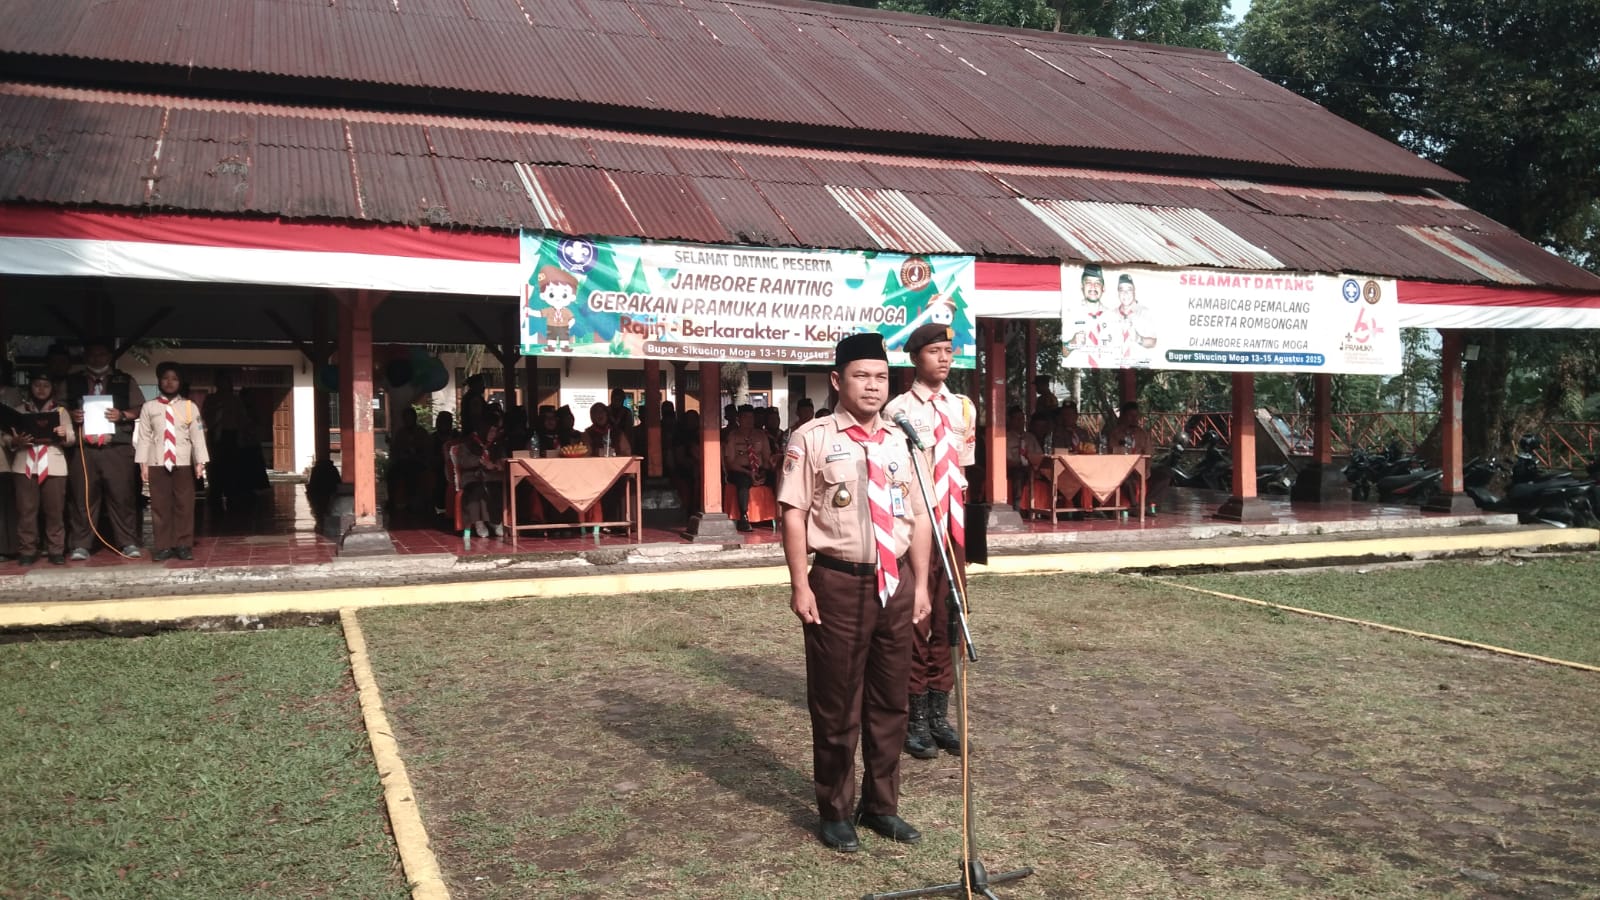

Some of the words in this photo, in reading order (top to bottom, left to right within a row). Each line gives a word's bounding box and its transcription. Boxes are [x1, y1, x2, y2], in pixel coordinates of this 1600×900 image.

[674, 250, 729, 267] SELAMAT
[734, 253, 778, 270] DATANG
[782, 258, 833, 273] PESERTA
[671, 273, 758, 294] JAMBORE
[760, 279, 833, 298] RANTING
[1179, 273, 1251, 288] SELAMAT
[1254, 277, 1315, 291] DATANG
[590, 292, 678, 314] GERAKAN
[682, 297, 767, 318] PRAMUKA
[771, 301, 857, 322] KWARRAN
[859, 306, 905, 324] MOGA
[1188, 297, 1250, 312] KAMABICAB
[1253, 299, 1311, 314] PEMALANG
[620, 315, 666, 339] Rajin
[682, 319, 790, 341] Berkarakter
[1189, 314, 1237, 328] BESERTA
[1239, 316, 1309, 331] ROMBONGAN
[1189, 336, 1198, 347] DI
[1199, 337, 1241, 348] JAMBORE
[1243, 338, 1279, 349] RANTING
[1282, 340, 1309, 350] MOGA
[647, 344, 678, 355] Buper
[682, 345, 726, 358] Sikucing
[729, 347, 756, 359] Moga
[760, 348, 787, 358] 13-15
[790, 350, 830, 361] Agustus
[1168, 351, 1191, 362] Buper
[1193, 352, 1227, 363] Sikucing
[1229, 353, 1249, 363] Moga
[1251, 354, 1271, 363] 13-15
[1273, 355, 1304, 364] Agustus
[1305, 355, 1322, 364] 2025
